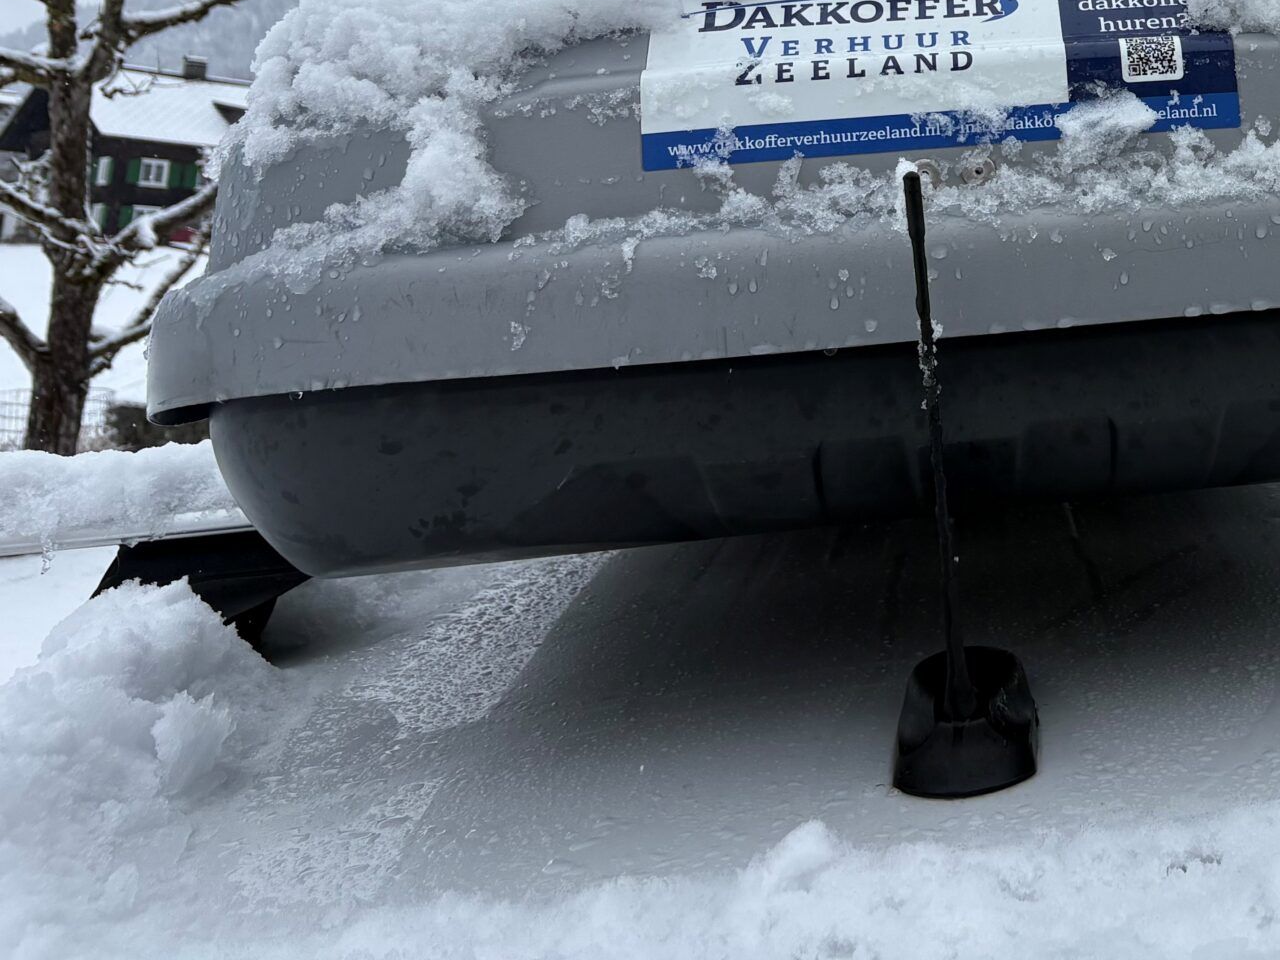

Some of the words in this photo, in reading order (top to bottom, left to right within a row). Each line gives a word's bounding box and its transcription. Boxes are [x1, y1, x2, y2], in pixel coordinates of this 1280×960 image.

[1097, 12, 1190, 32] huren?
[740, 30, 972, 59] VERHUUR
[734, 51, 973, 86] ZEELAND
[667, 122, 941, 156] www.dkkofferverhuurzeeland.nl
